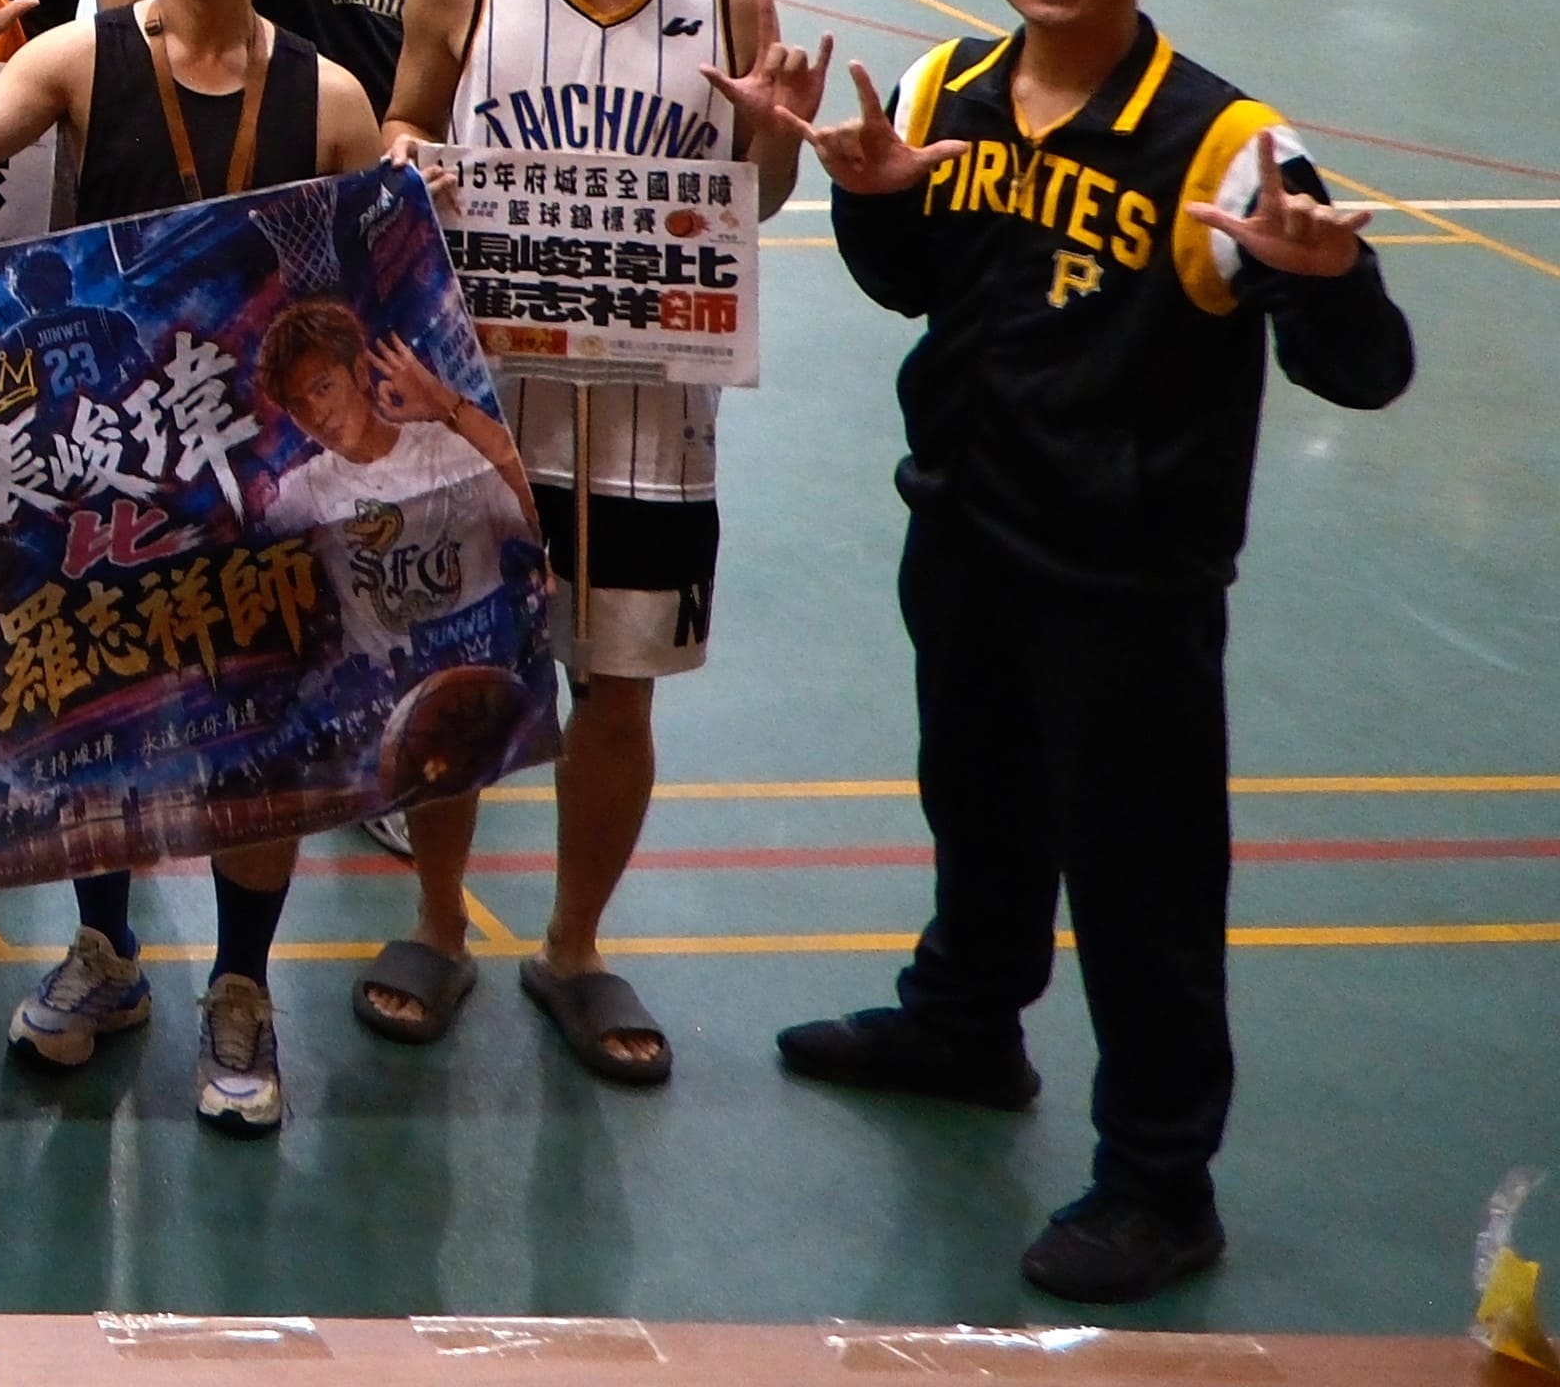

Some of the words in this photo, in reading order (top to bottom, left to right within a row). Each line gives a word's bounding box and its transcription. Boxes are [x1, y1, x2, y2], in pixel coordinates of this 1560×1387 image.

[508, 199, 656, 234] 籃球錦標賽
[926, 139, 1156, 270] PIRATES
[1047, 254, 1103, 310] P
[37, 320, 89, 348] JUNWEI
[43, 341, 101, 396] 23
[61, 500, 206, 578] 比
